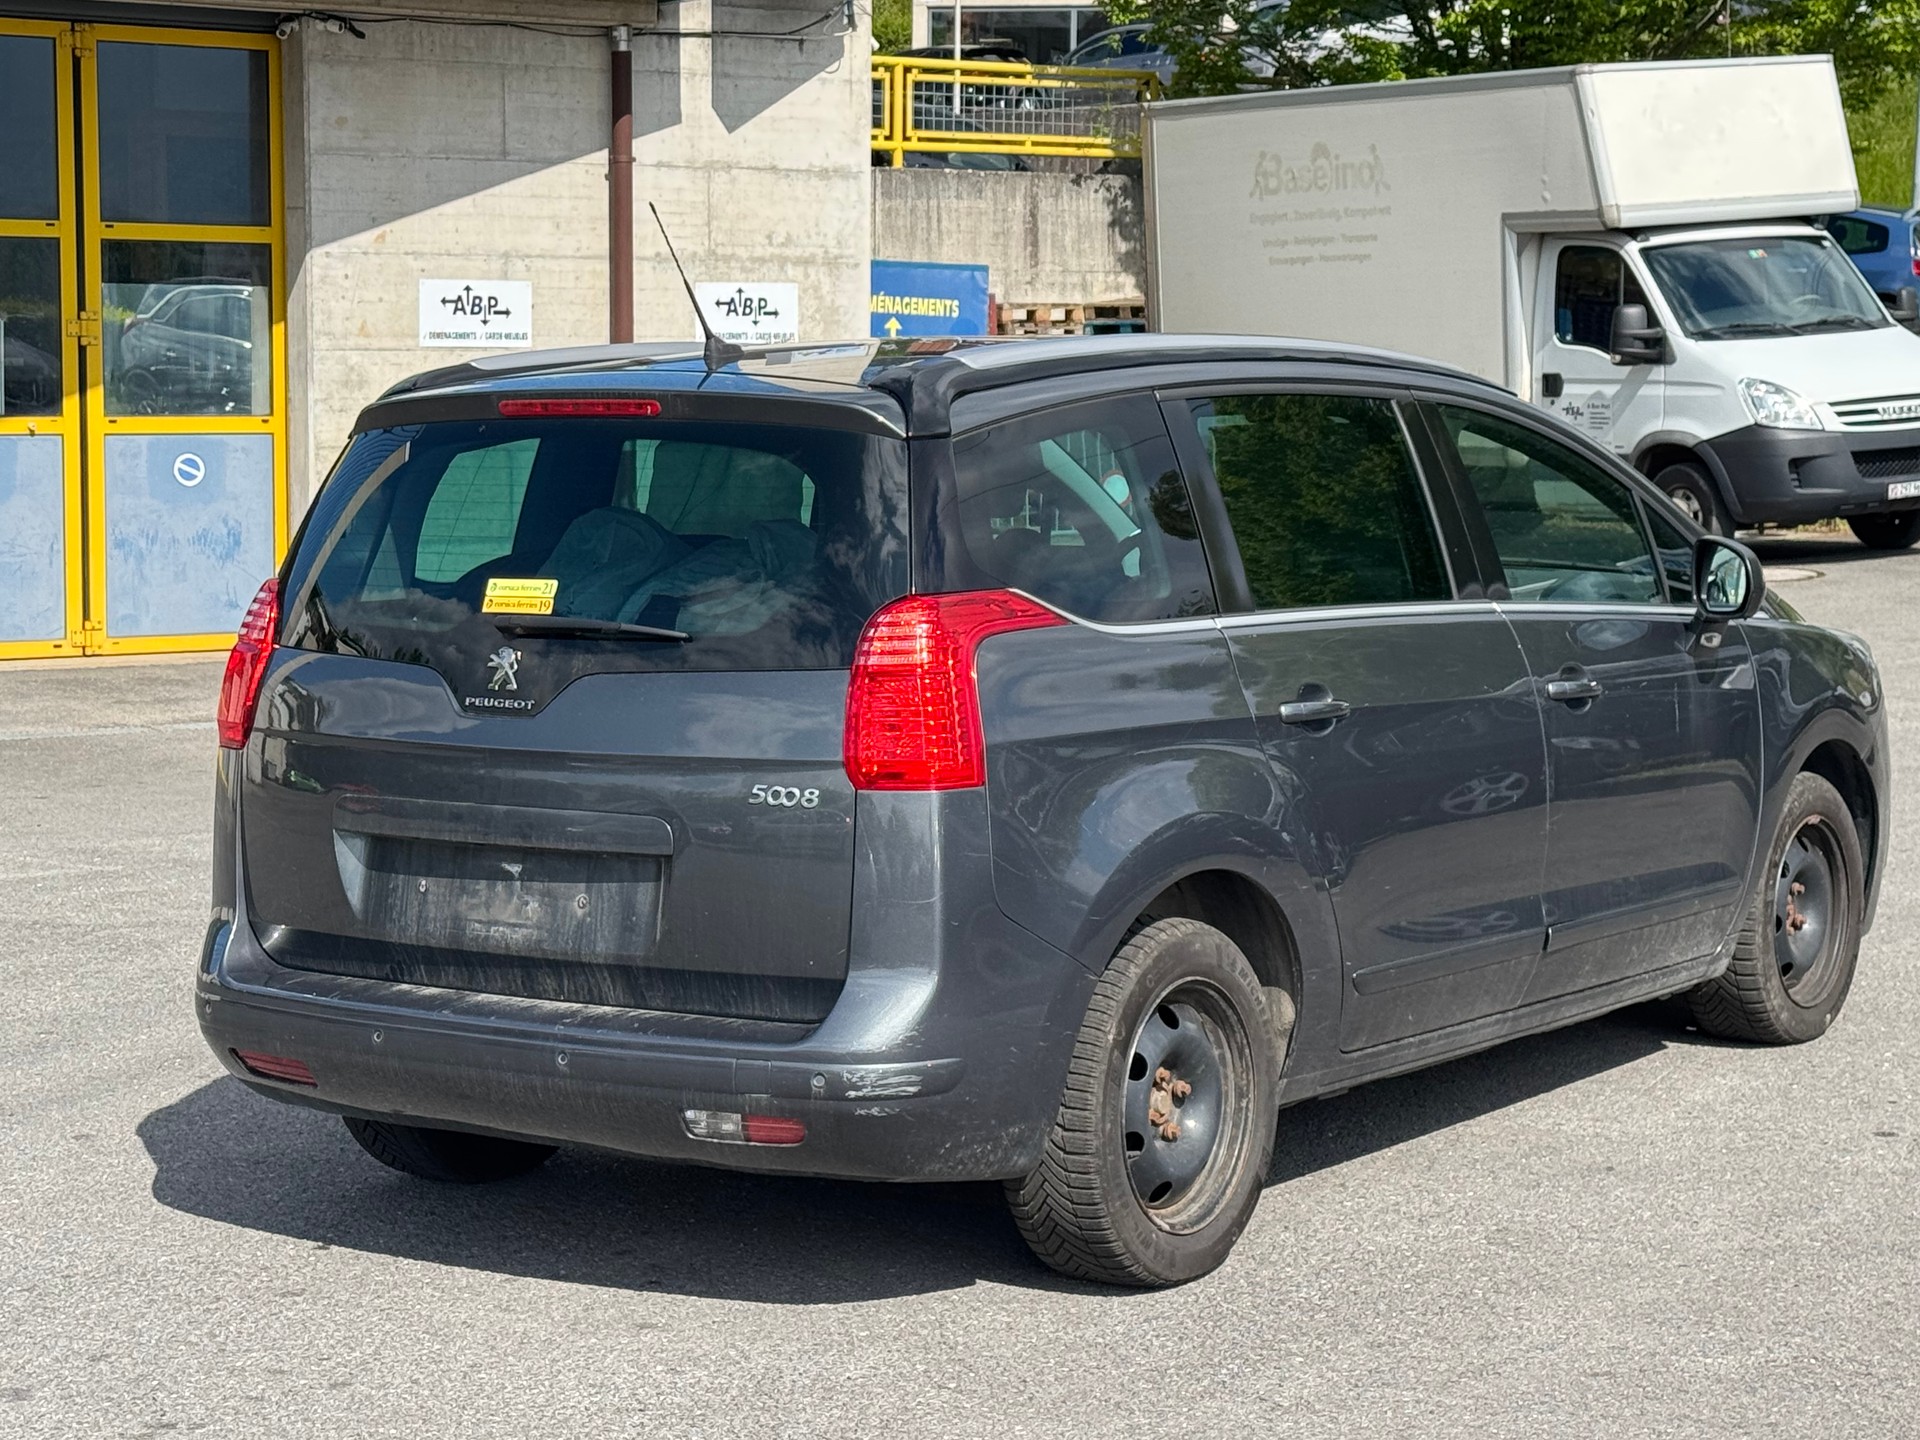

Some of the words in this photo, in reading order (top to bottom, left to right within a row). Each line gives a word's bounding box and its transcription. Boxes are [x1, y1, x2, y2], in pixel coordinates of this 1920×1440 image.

[870, 291, 960, 318] MÉNAGEMENTS
[541, 582, 554, 595] 21
[516, 599, 538, 609] ferries
[538, 599, 551, 612] 19
[465, 697, 535, 710] PEUGEOT
[747, 783, 820, 809] 5008
